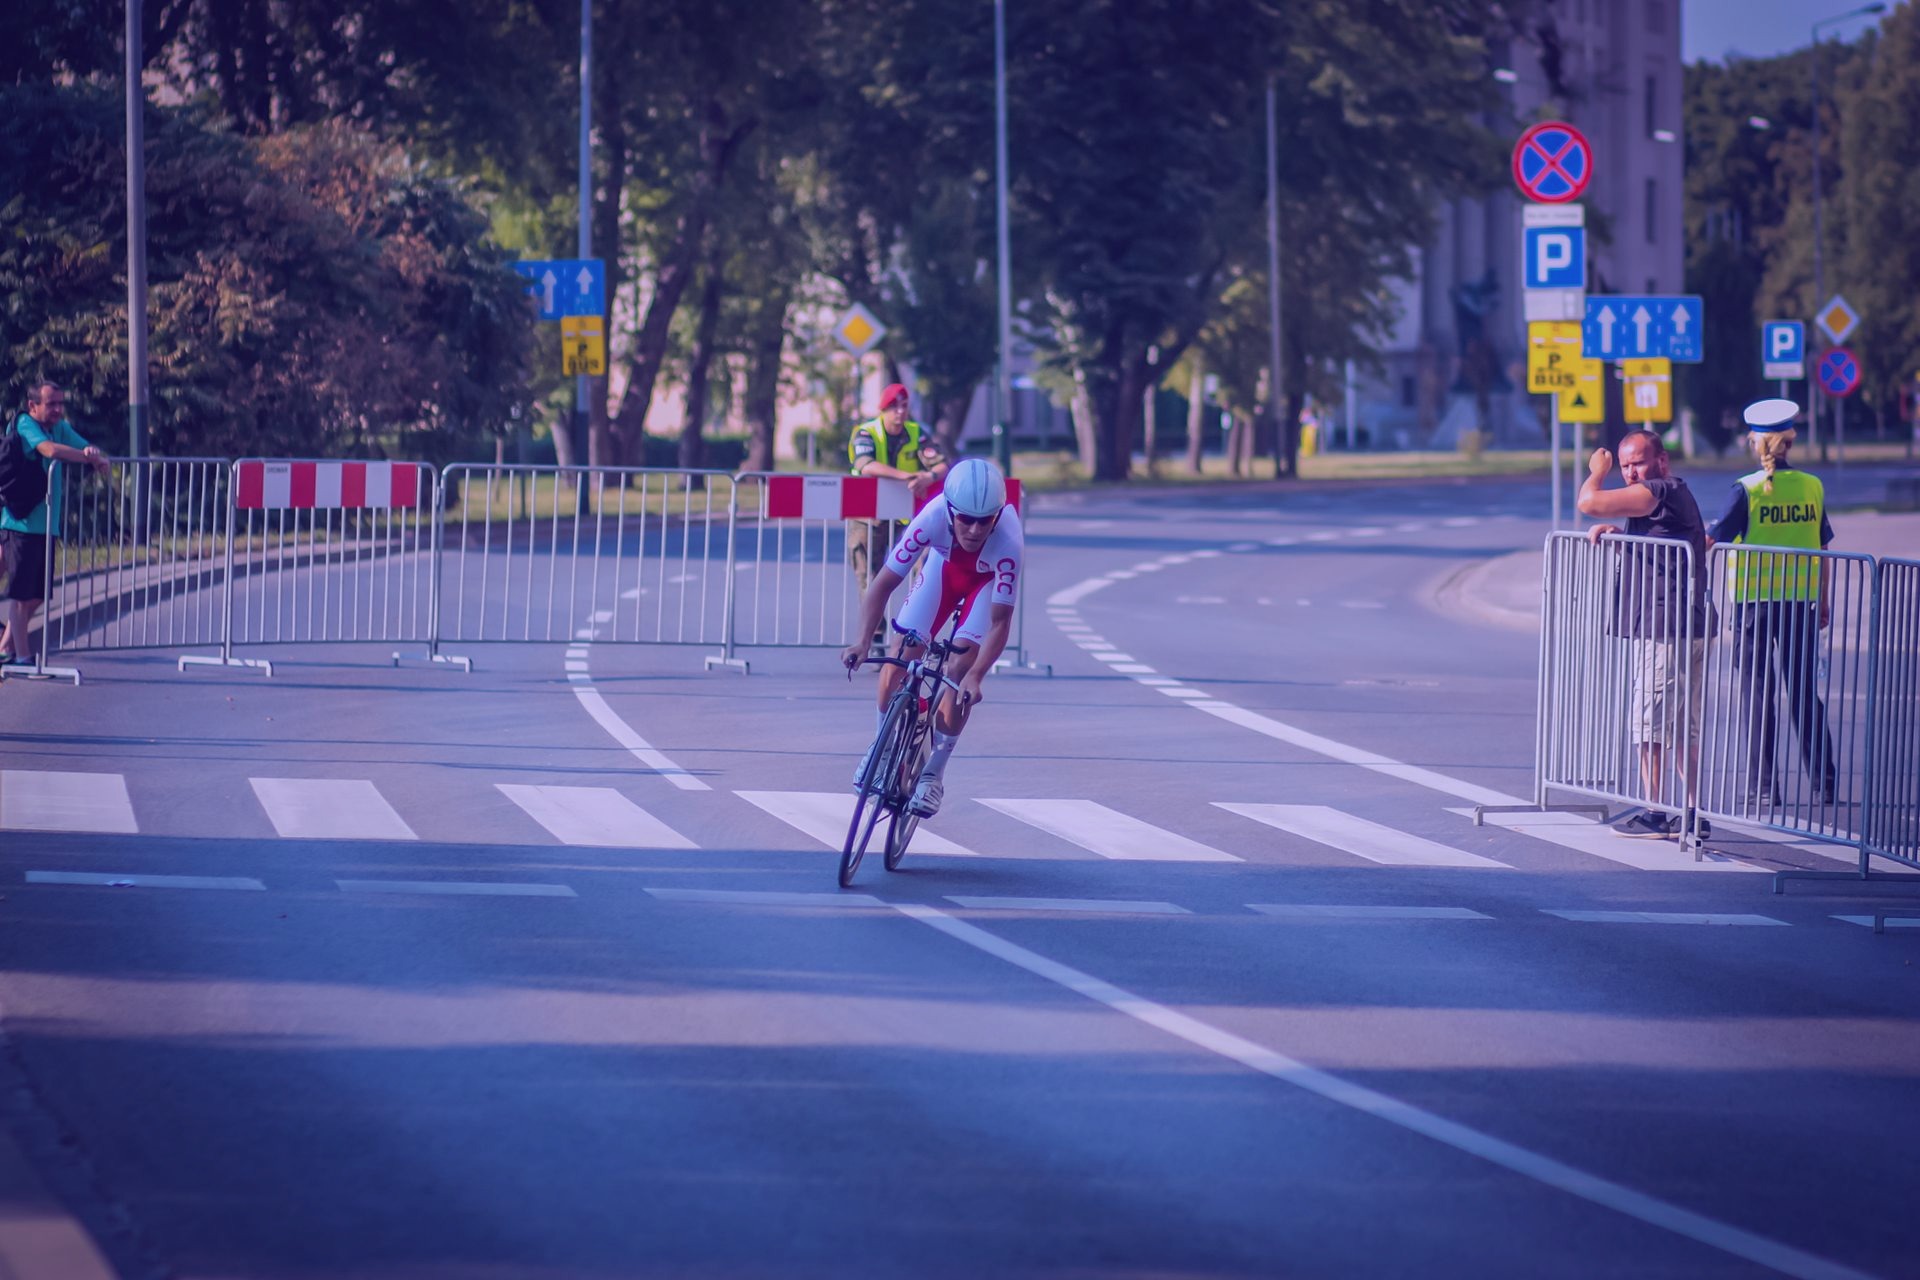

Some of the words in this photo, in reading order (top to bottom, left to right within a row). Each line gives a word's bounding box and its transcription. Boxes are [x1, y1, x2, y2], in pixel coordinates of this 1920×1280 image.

[1538, 233, 1571, 282] P
[1773, 327, 1794, 359] P
[1549, 353, 1561, 369] P
[1535, 373, 1575, 387] BUS
[1760, 504, 1817, 524] POLICJA
[895, 528, 931, 564] CCC
[997, 557, 1016, 595] CCC
